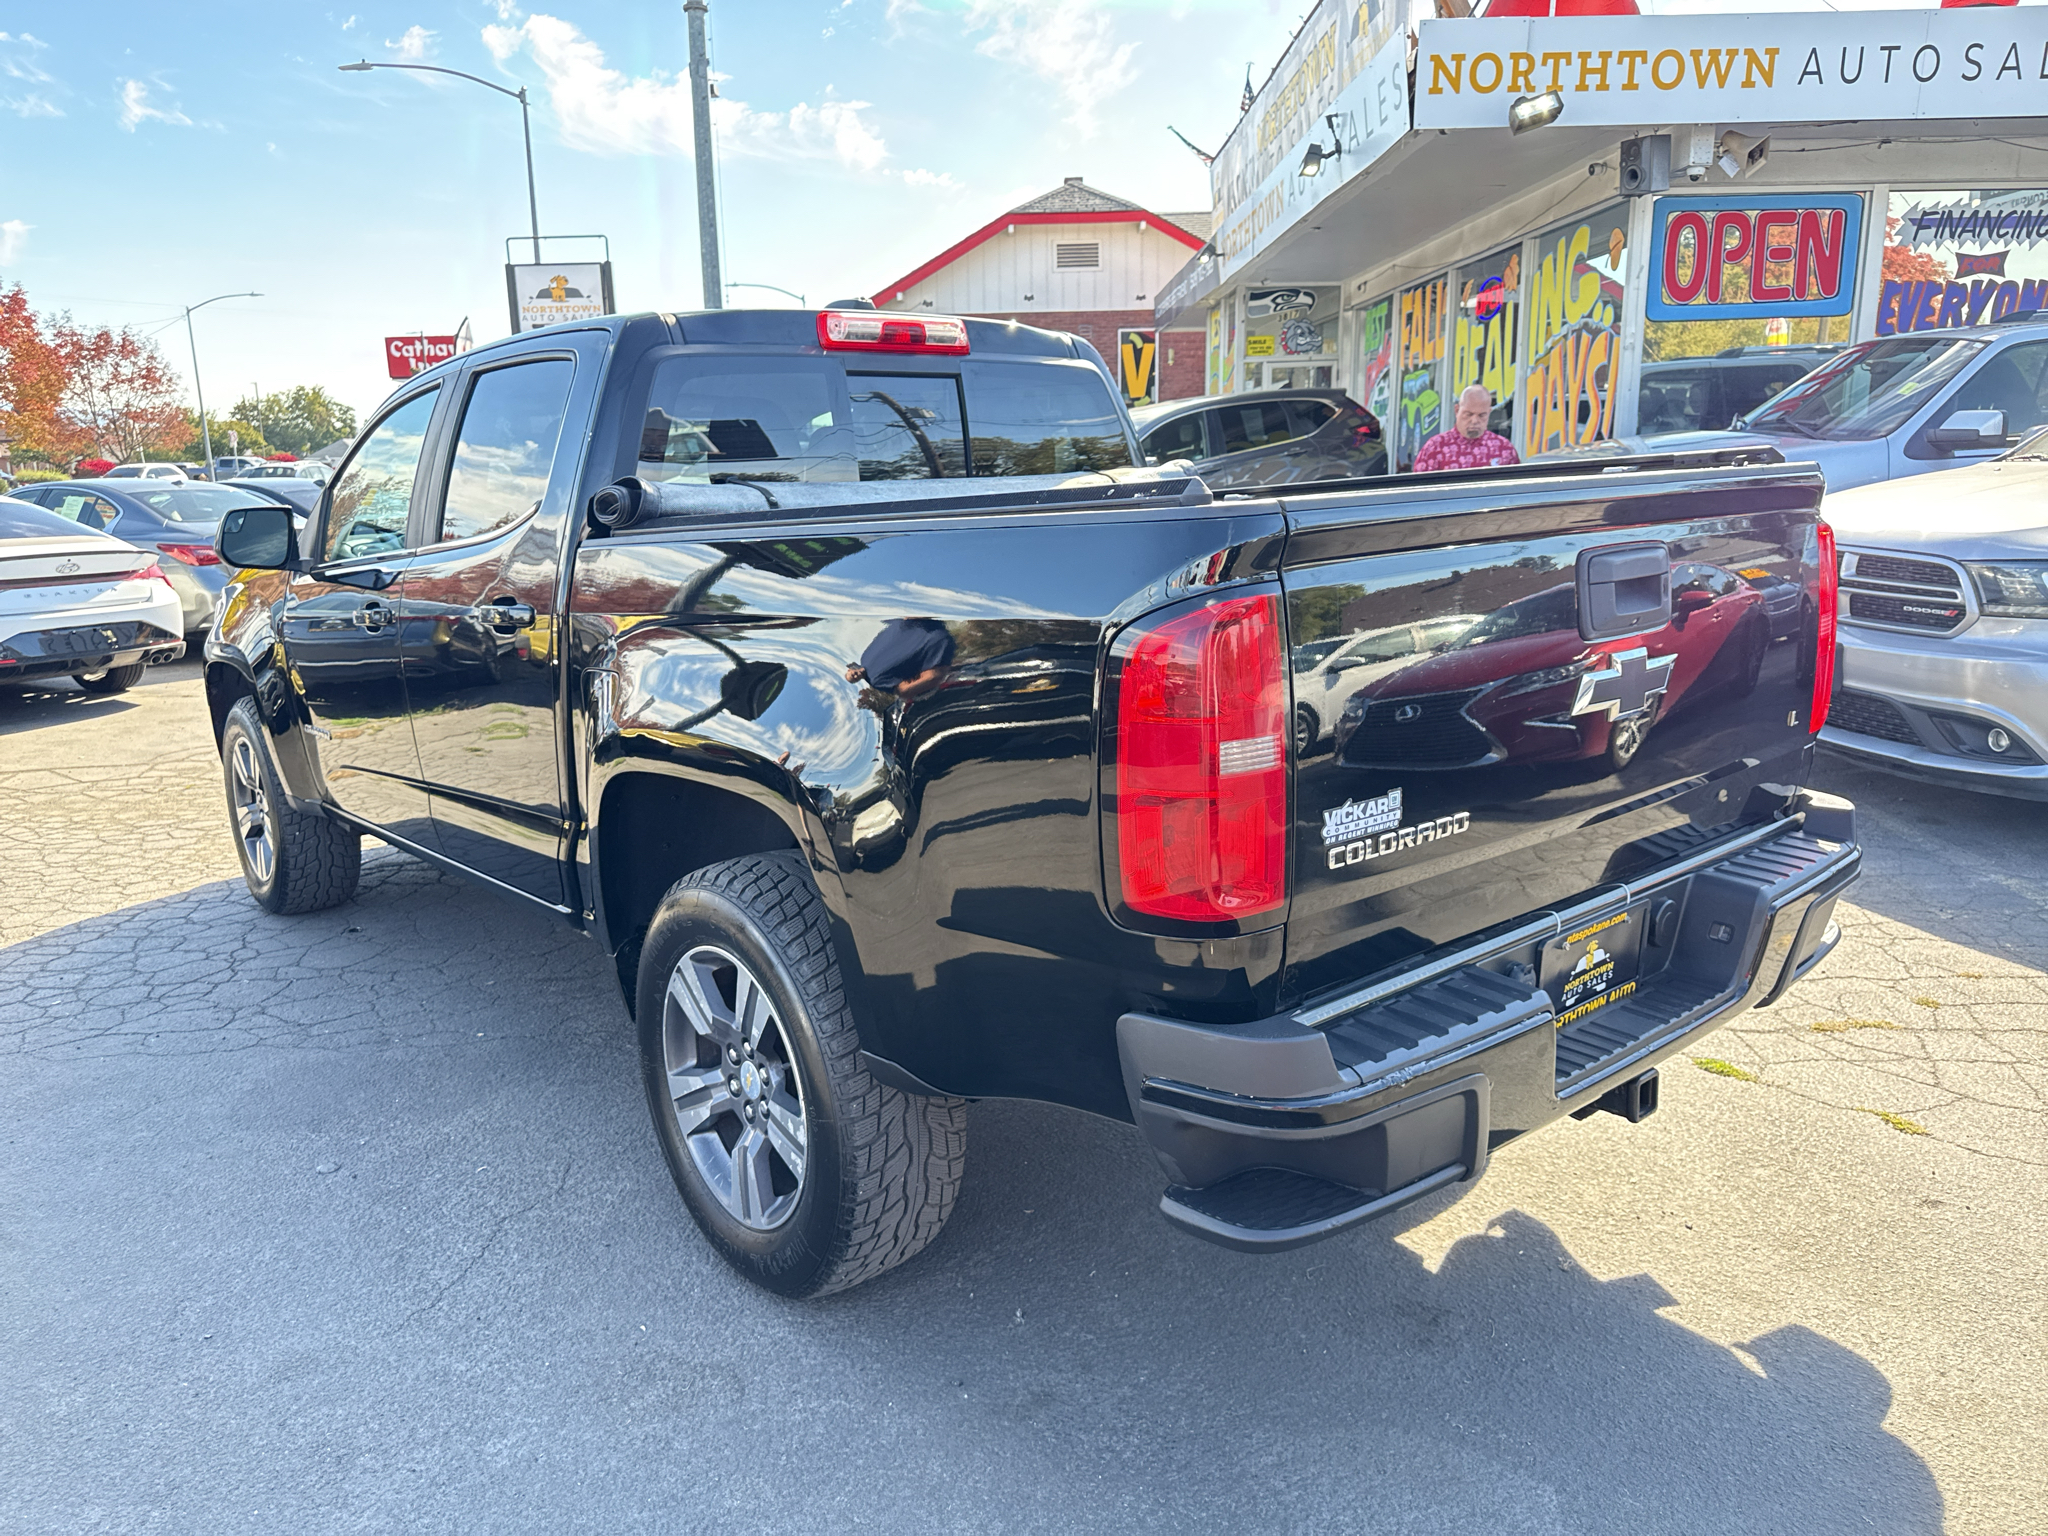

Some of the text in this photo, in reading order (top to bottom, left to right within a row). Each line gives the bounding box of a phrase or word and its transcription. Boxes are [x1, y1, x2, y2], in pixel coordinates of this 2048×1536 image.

[1428, 47, 1780, 96] NORTHTOWN
[1798, 43, 1941, 86] AUTO
[1220, 179, 1285, 267] NORTHTOWN
[1288, 139, 1327, 206] AUO
[1334, 61, 1403, 161] ALES
[1662, 208, 1848, 305] OPEN
[1960, 256, 2001, 274] FOR
[521, 304, 601, 314] NORTHTOWN
[1475, 281, 1504, 316] OPEN
[521, 312, 602, 322] AUTO SALE
[1902, 605, 1948, 615] DODGE
[1325, 797, 1389, 827] VICKAR
[1325, 812, 1399, 836] COMMUNITY
[1325, 819, 1399, 845] ON REGENT WINNIPEG
[1327, 811, 1471, 870] COLORADO
[1566, 912, 1628, 944] ntaspokane.com
[1561, 970, 1614, 1002] AUTO SALES
[1563, 961, 1615, 993] NORTHTOWN
[1556, 981, 1637, 1029] RTHTOWN AUTO
